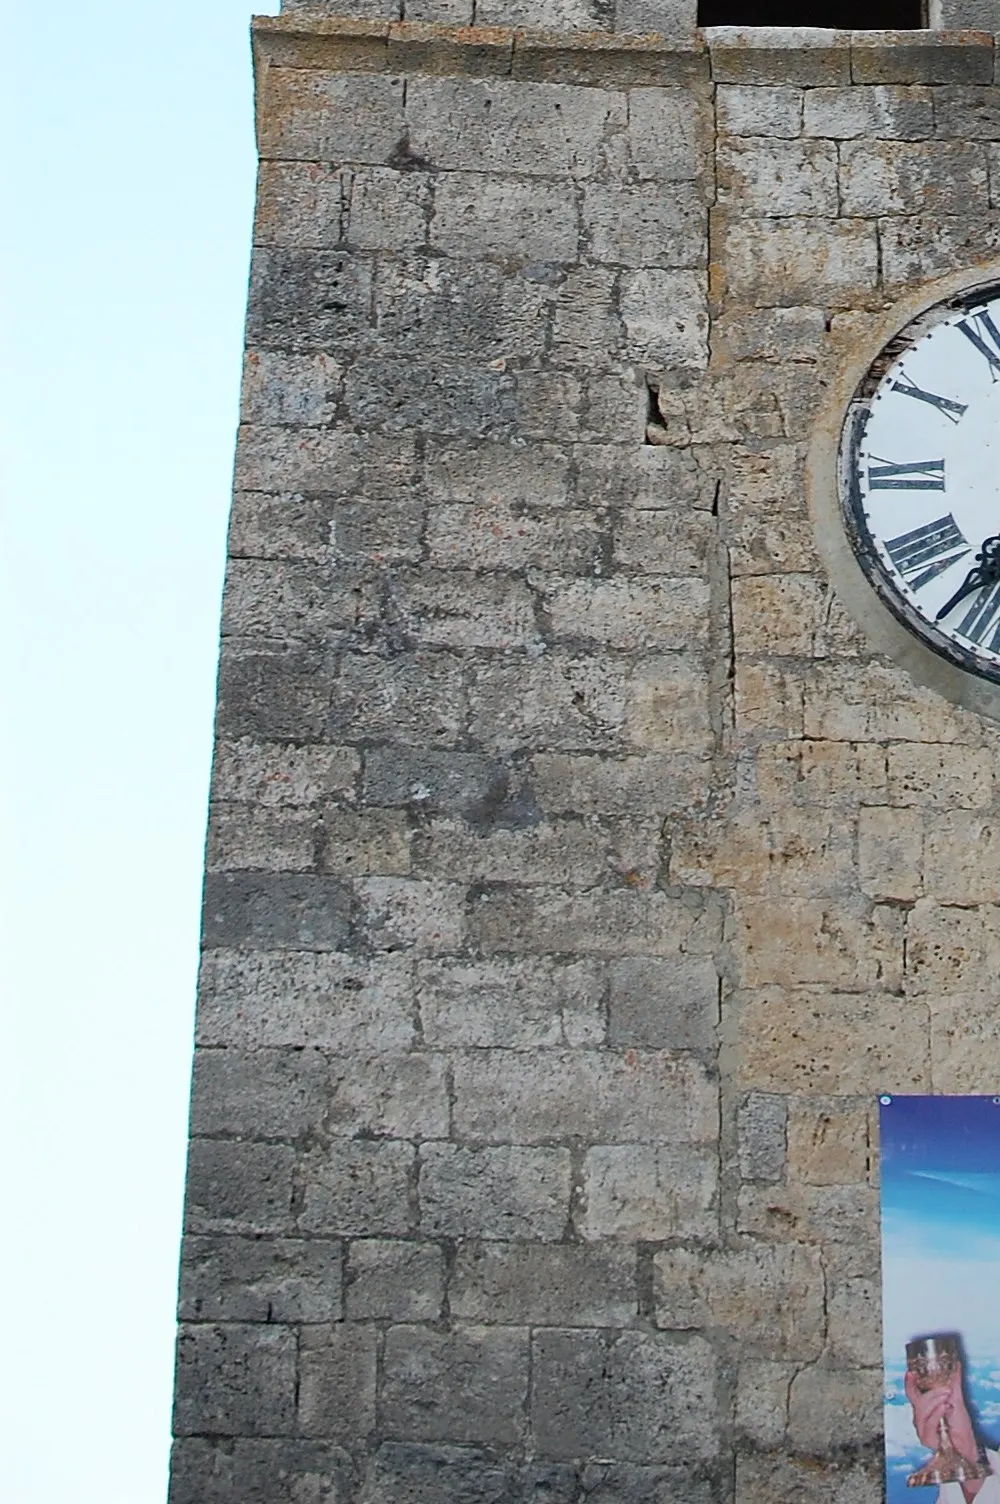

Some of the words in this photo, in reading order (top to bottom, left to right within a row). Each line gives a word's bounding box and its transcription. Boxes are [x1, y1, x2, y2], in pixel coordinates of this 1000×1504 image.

[891, 371, 969, 424] X
[867, 453, 946, 492] IX
[884, 513, 971, 592] VIII
